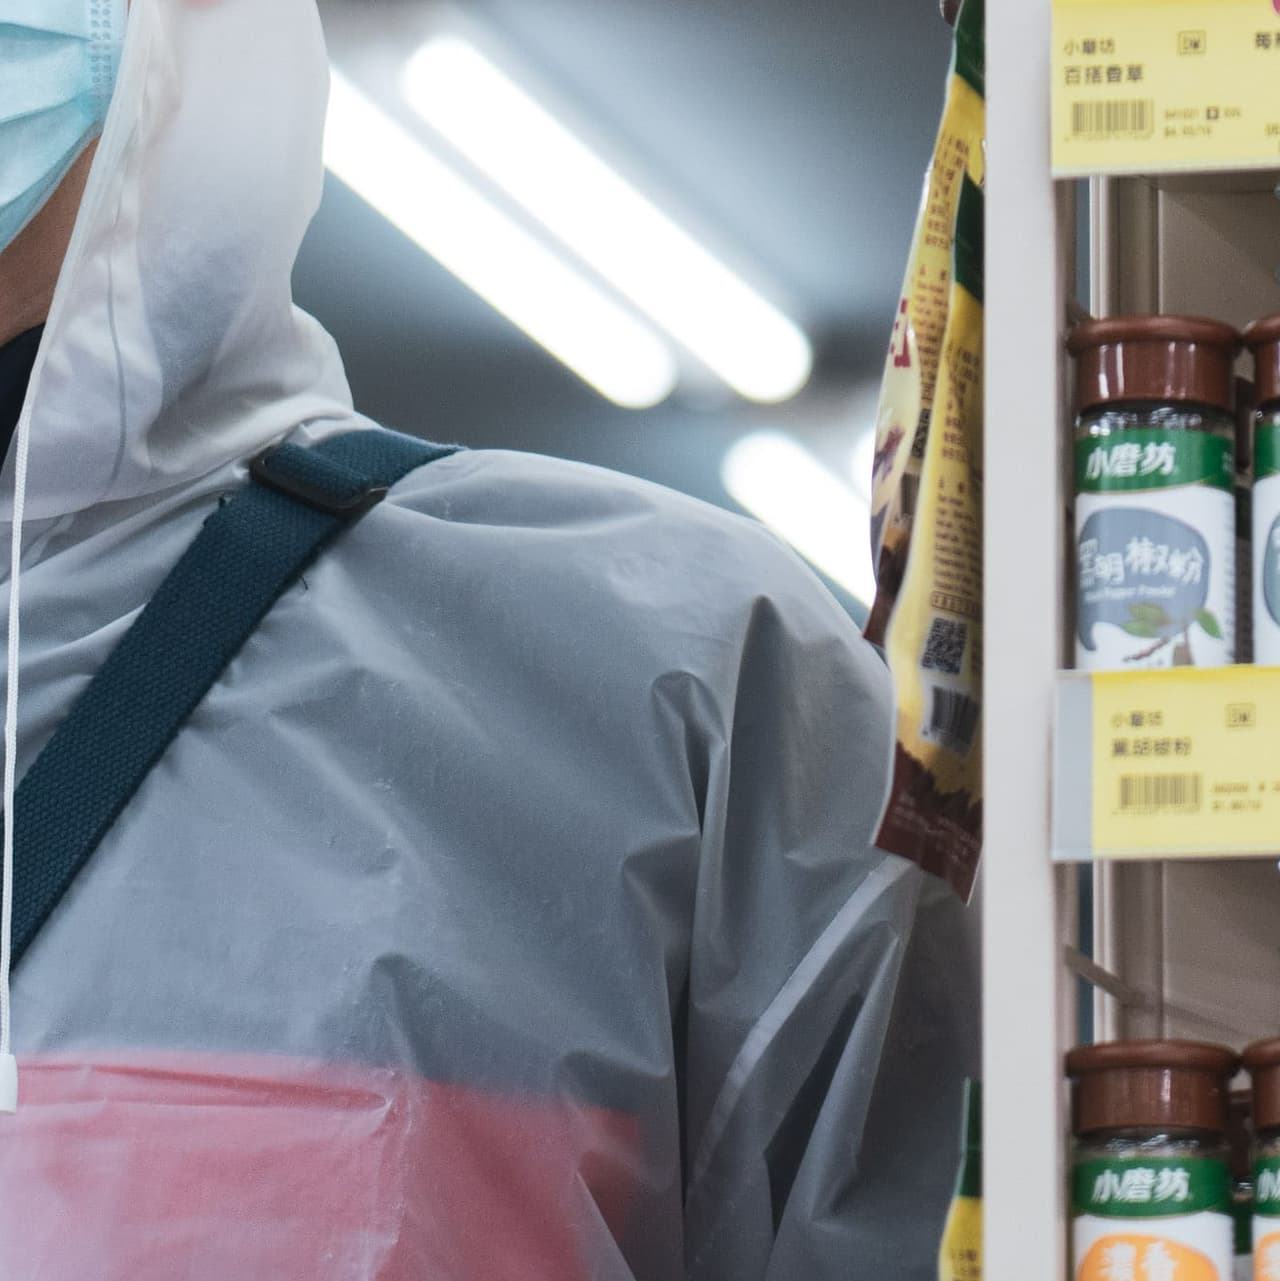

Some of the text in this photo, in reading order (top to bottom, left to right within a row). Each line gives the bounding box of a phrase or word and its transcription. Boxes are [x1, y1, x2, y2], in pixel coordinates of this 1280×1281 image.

[1086, 442, 1176, 479] 小磨坊
[1091, 1167, 1192, 1203] 小磨坊
